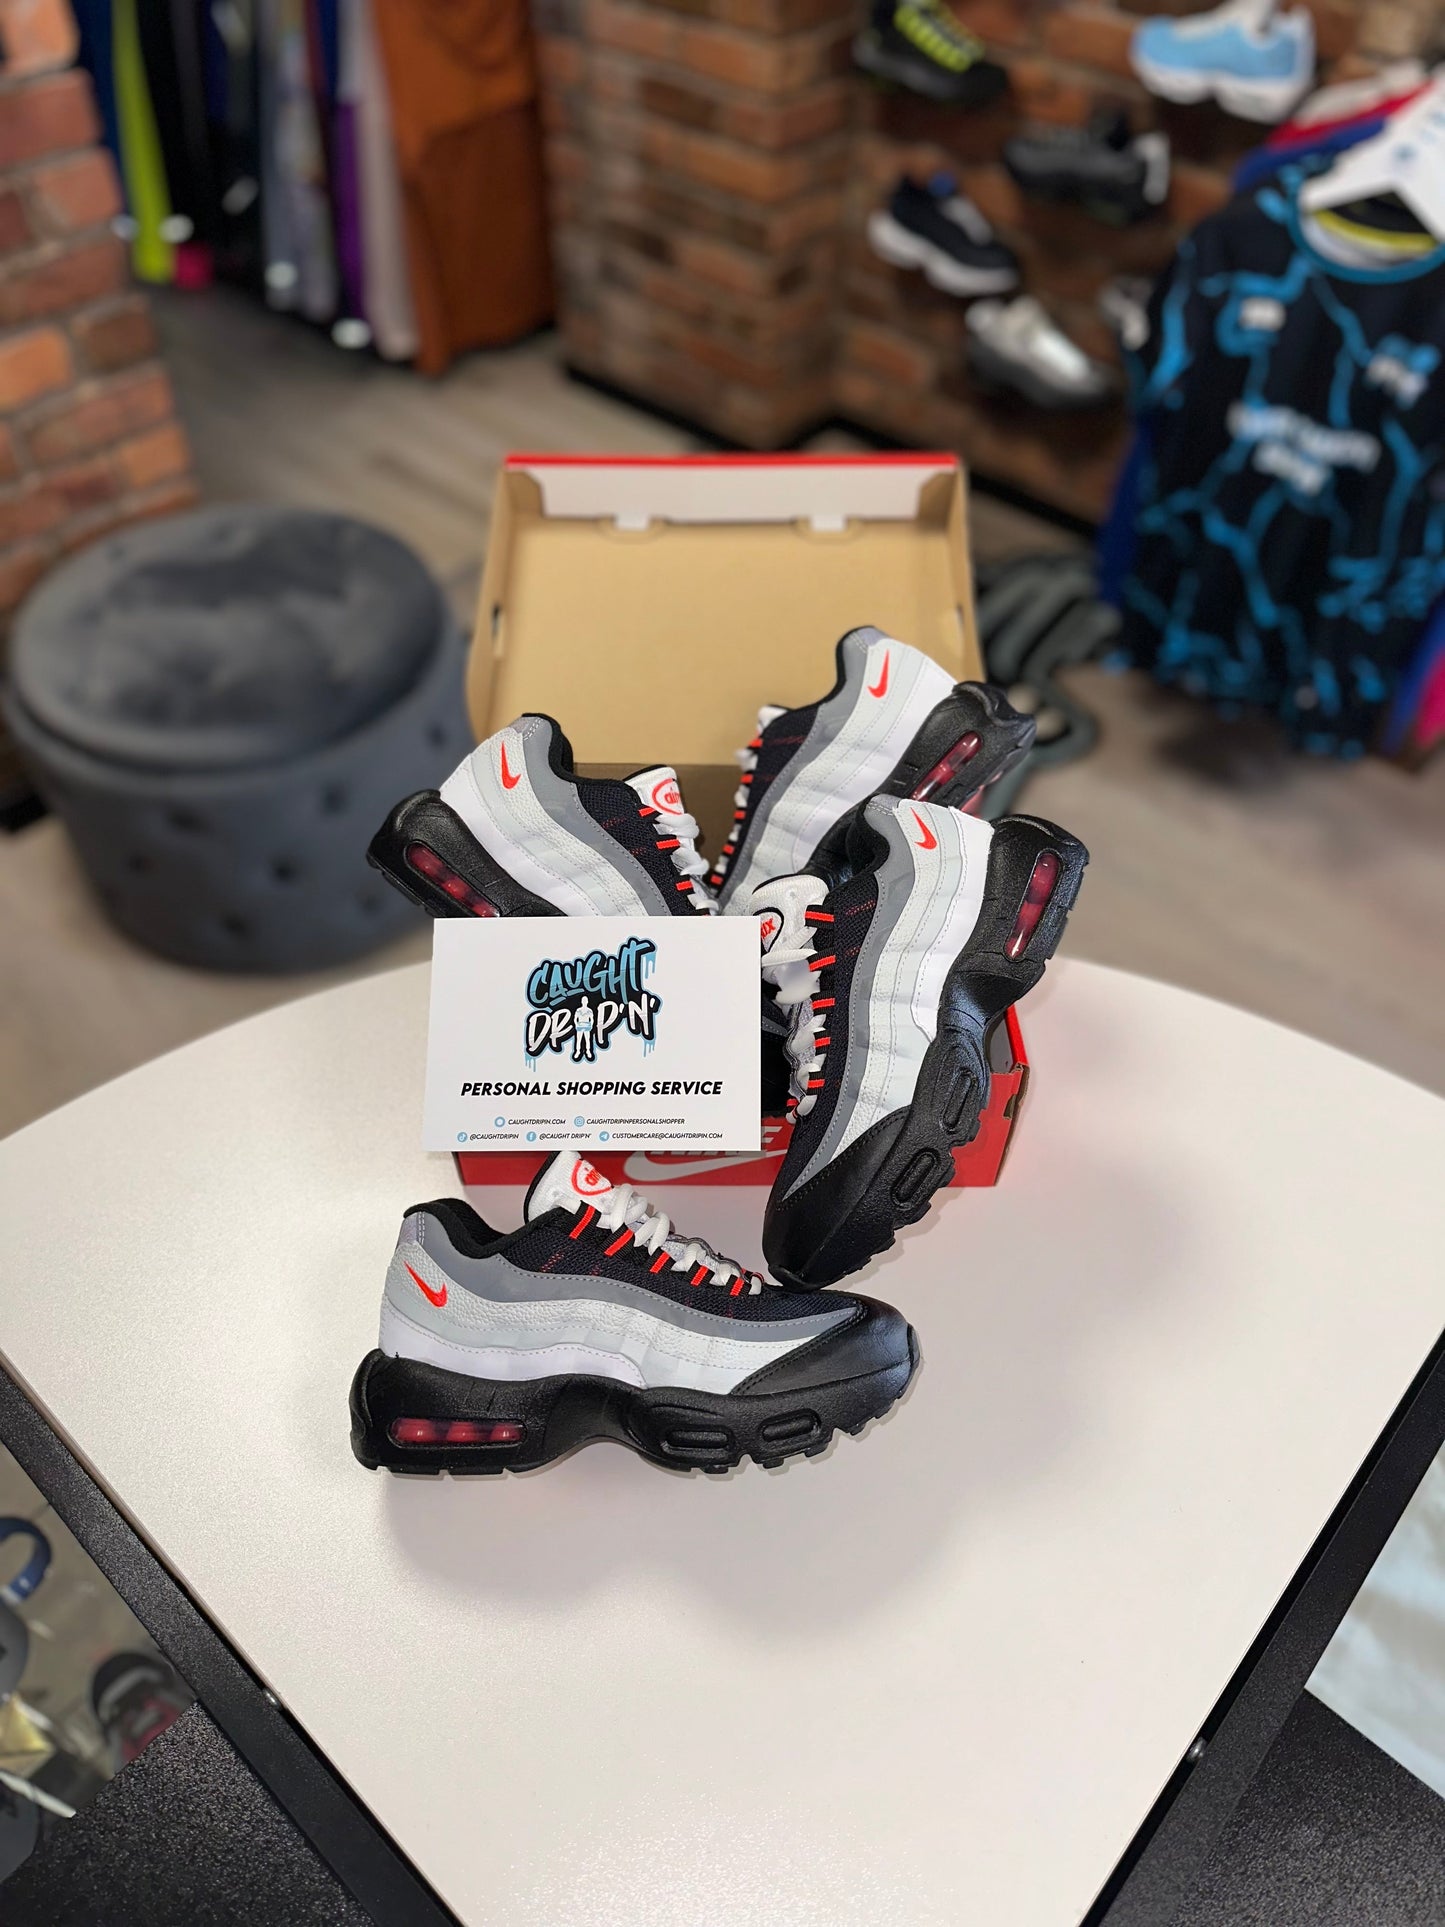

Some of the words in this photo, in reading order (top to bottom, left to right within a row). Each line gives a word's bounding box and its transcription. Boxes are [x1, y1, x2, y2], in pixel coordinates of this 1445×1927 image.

[528, 938, 652, 1006] CAUGHT
[461, 1082, 551, 1096] PERSONAL
[556, 1081, 646, 1096] SHOPPING
[650, 1081, 723, 1095] SERVICE
[611, 1132, 723, 1140] CUSTOMERCARE@CAUGHTDRIPIN.COM
